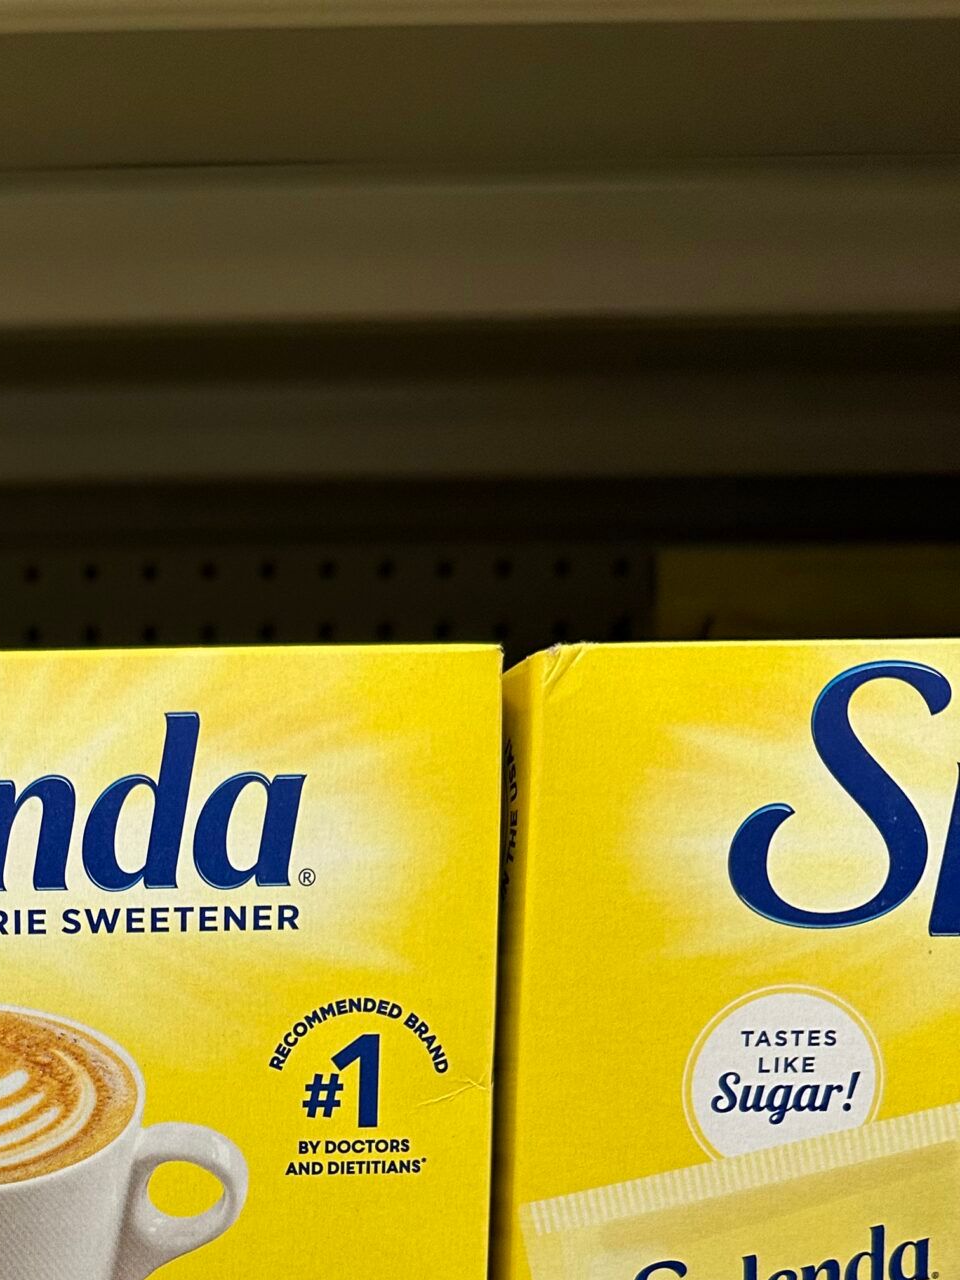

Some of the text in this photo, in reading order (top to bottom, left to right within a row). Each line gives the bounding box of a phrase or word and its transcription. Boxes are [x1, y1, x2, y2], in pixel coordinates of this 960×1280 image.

[727, 660, 960, 937] S
[61, 904, 300, 934] SWEETENER
[269, 997, 449, 1075] RECOMMENDED BRAND
[740, 1030, 838, 1047] TASTES
[757, 1056, 816, 1074] LIKE
[301, 1033, 381, 1128] #1
[710, 1071, 861, 1125] Sugar!
[298, 1138, 410, 1155] BY DOCTORS
[285, 1160, 324, 1176] AND
